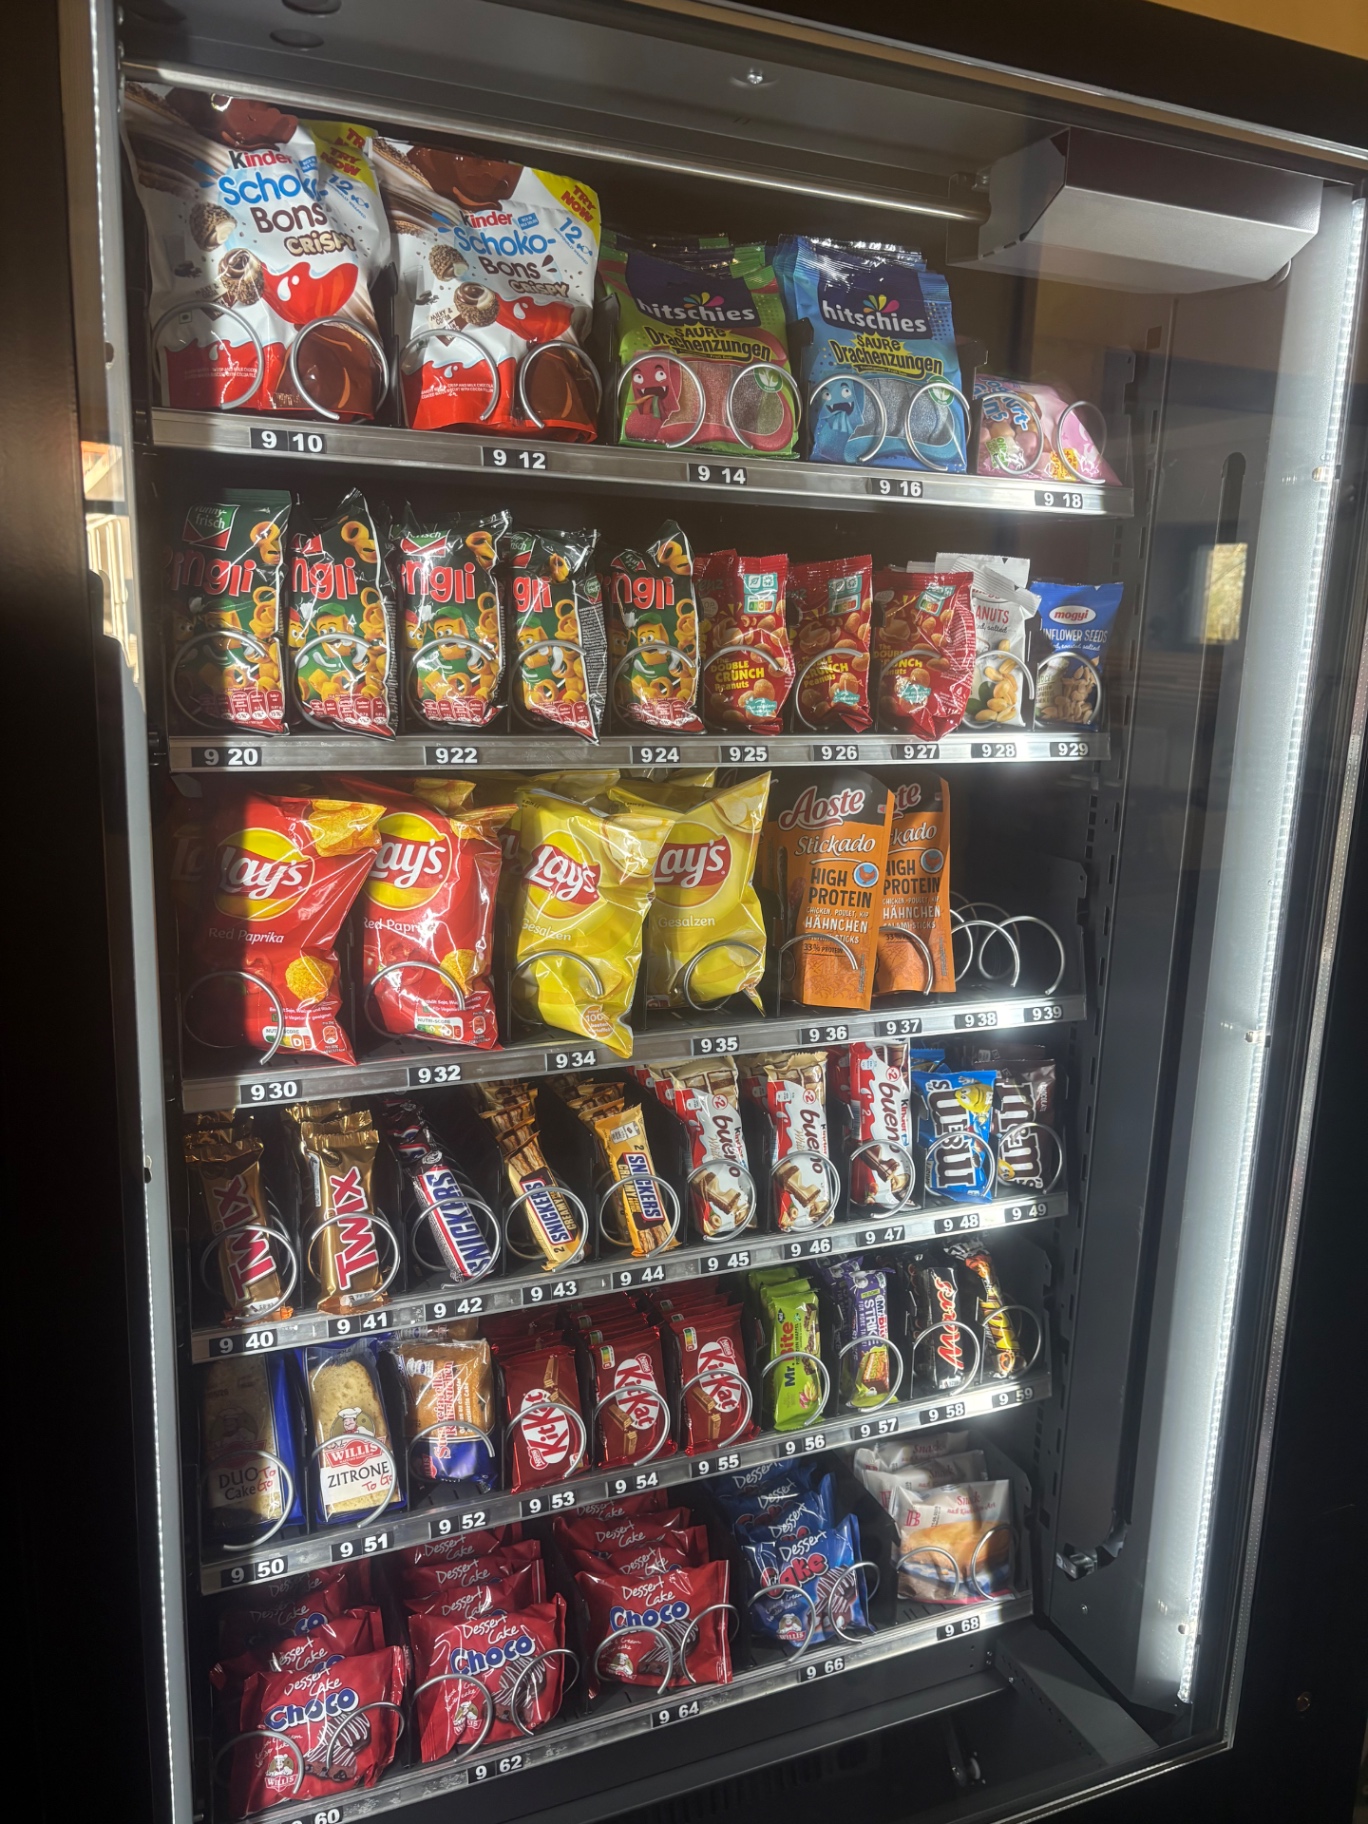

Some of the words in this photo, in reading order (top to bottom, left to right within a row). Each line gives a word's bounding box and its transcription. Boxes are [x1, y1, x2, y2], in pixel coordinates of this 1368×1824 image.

[326, 173, 354, 196] 12
[560, 190, 594, 223] NOW
[574, 185, 597, 212] TRY
[250, 202, 328, 233] Bons
[453, 227, 557, 256] Schoko-
[559, 217, 583, 245] 12
[478, 255, 541, 280] Bons
[636, 297, 756, 322] hitschies
[822, 299, 927, 332] hitschies
[643, 326, 772, 361] Drachenzungen
[828, 339, 943, 376] Drachenzungen
[194, 514, 226, 529] frisch
[1054, 609, 1089, 622] mogyi
[1084, 630, 1108, 644] SEEDS
[710, 660, 750, 673] DOUBLE
[715, 667, 765, 683] CRUNCH
[714, 680, 750, 692] Peanuts
[779, 785, 865, 830] Aoste
[795, 834, 876, 856] Stickado
[221, 845, 308, 900] Lay's
[524, 846, 597, 902] Lay's
[811, 867, 848, 887] HIGH
[808, 888, 872, 908] PROTEIN
[883, 877, 941, 895] PROTEIN
[658, 915, 716, 929] Gesalzen
[804, 915, 868, 934] HÄHNCHEN
[882, 905, 941, 920] HÄHNCHEN
[208, 928, 235, 939] Red
[238, 929, 285, 945] Paprika
[521, 918, 571, 941] Gesalzen
[293, 1036, 302, 1047] D
[878, 1082, 901, 1154] bueno
[712, 1114, 741, 1178] bueno
[800, 1109, 823, 1174] bueno
[425, 1171, 493, 1276] SNICKERS
[524, 1181, 572, 1245] SNICKERS
[554, 1196, 577, 1231] CREAMY
[329, 1166, 380, 1290] TWIX
[934, 1276, 965, 1370] Mars
[784, 1362, 796, 1387] Mr.
[332, 1442, 379, 1463] WILLIS
[219, 1466, 259, 1488] DUO
[258, 1466, 276, 1480] To
[327, 1461, 390, 1488] ZITRONE
[362, 1482, 377, 1492] To
[224, 1486, 256, 1501] Cake
[257, 1479, 273, 1493] Go
[757, 1479, 798, 1509] Dessert
[595, 1521, 635, 1543] Dessert
[768, 1502, 807, 1539] Dessert
[424, 1536, 466, 1556] Dessert
[618, 1531, 646, 1548] Cake
[779, 1530, 828, 1561] Dessert
[446, 1545, 475, 1560] Cake
[620, 1547, 657, 1574] Dessert
[436, 1558, 479, 1584] Dessert
[461, 1569, 490, 1588] Cake
[621, 1576, 665, 1600] Dessert
[645, 1591, 676, 1607] Cake
[278, 1605, 310, 1625] Cake
[441, 1589, 483, 1616] Dessert
[465, 1601, 494, 1621] Cake
[461, 1614, 507, 1639] Dessert
[609, 1601, 690, 1635] Choco
[488, 1624, 519, 1645] Cake
[295, 1647, 328, 1671] Cake
[450, 1635, 536, 1677] Choco
[284, 1666, 331, 1697] Dessert
[309, 1676, 342, 1697] Cake
[264, 1687, 359, 1732] Choco
